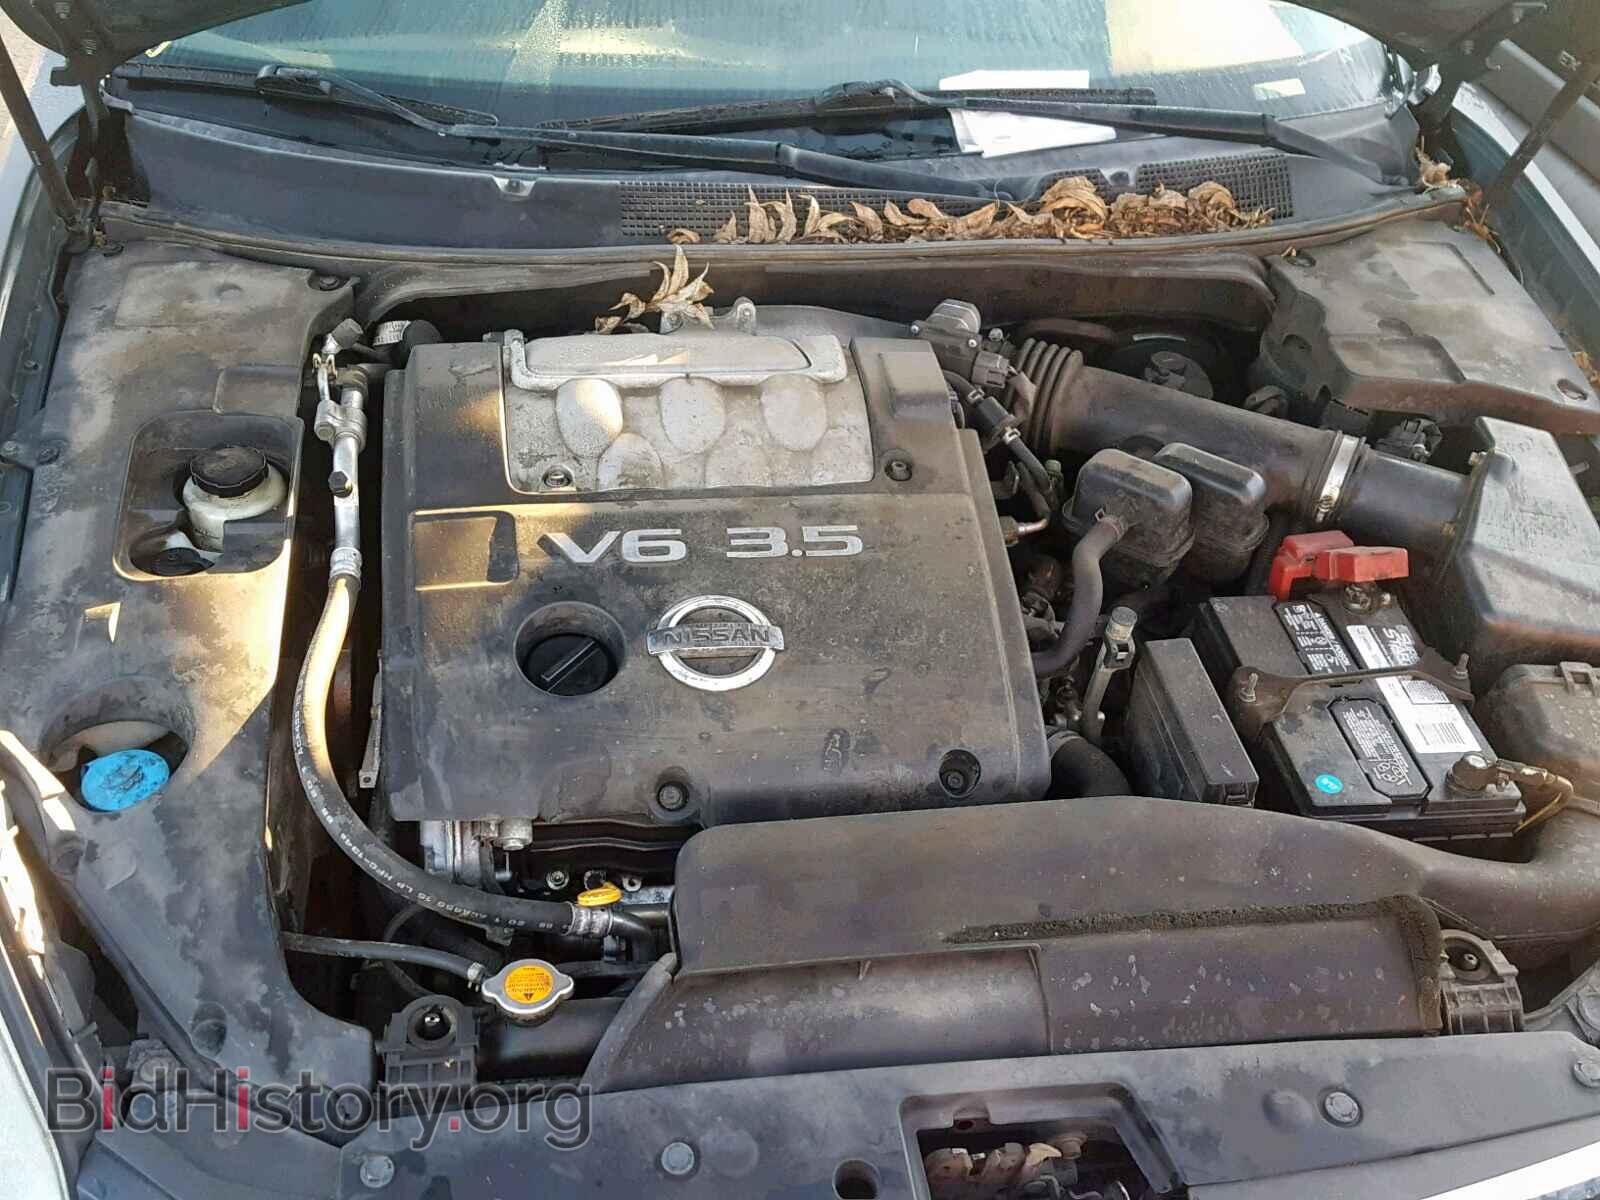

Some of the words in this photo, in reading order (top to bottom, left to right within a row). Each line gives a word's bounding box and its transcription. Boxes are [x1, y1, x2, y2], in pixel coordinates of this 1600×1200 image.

[538, 528, 688, 563] V6
[726, 525, 864, 559] 3.5
[662, 625, 771, 646] NISSAN
